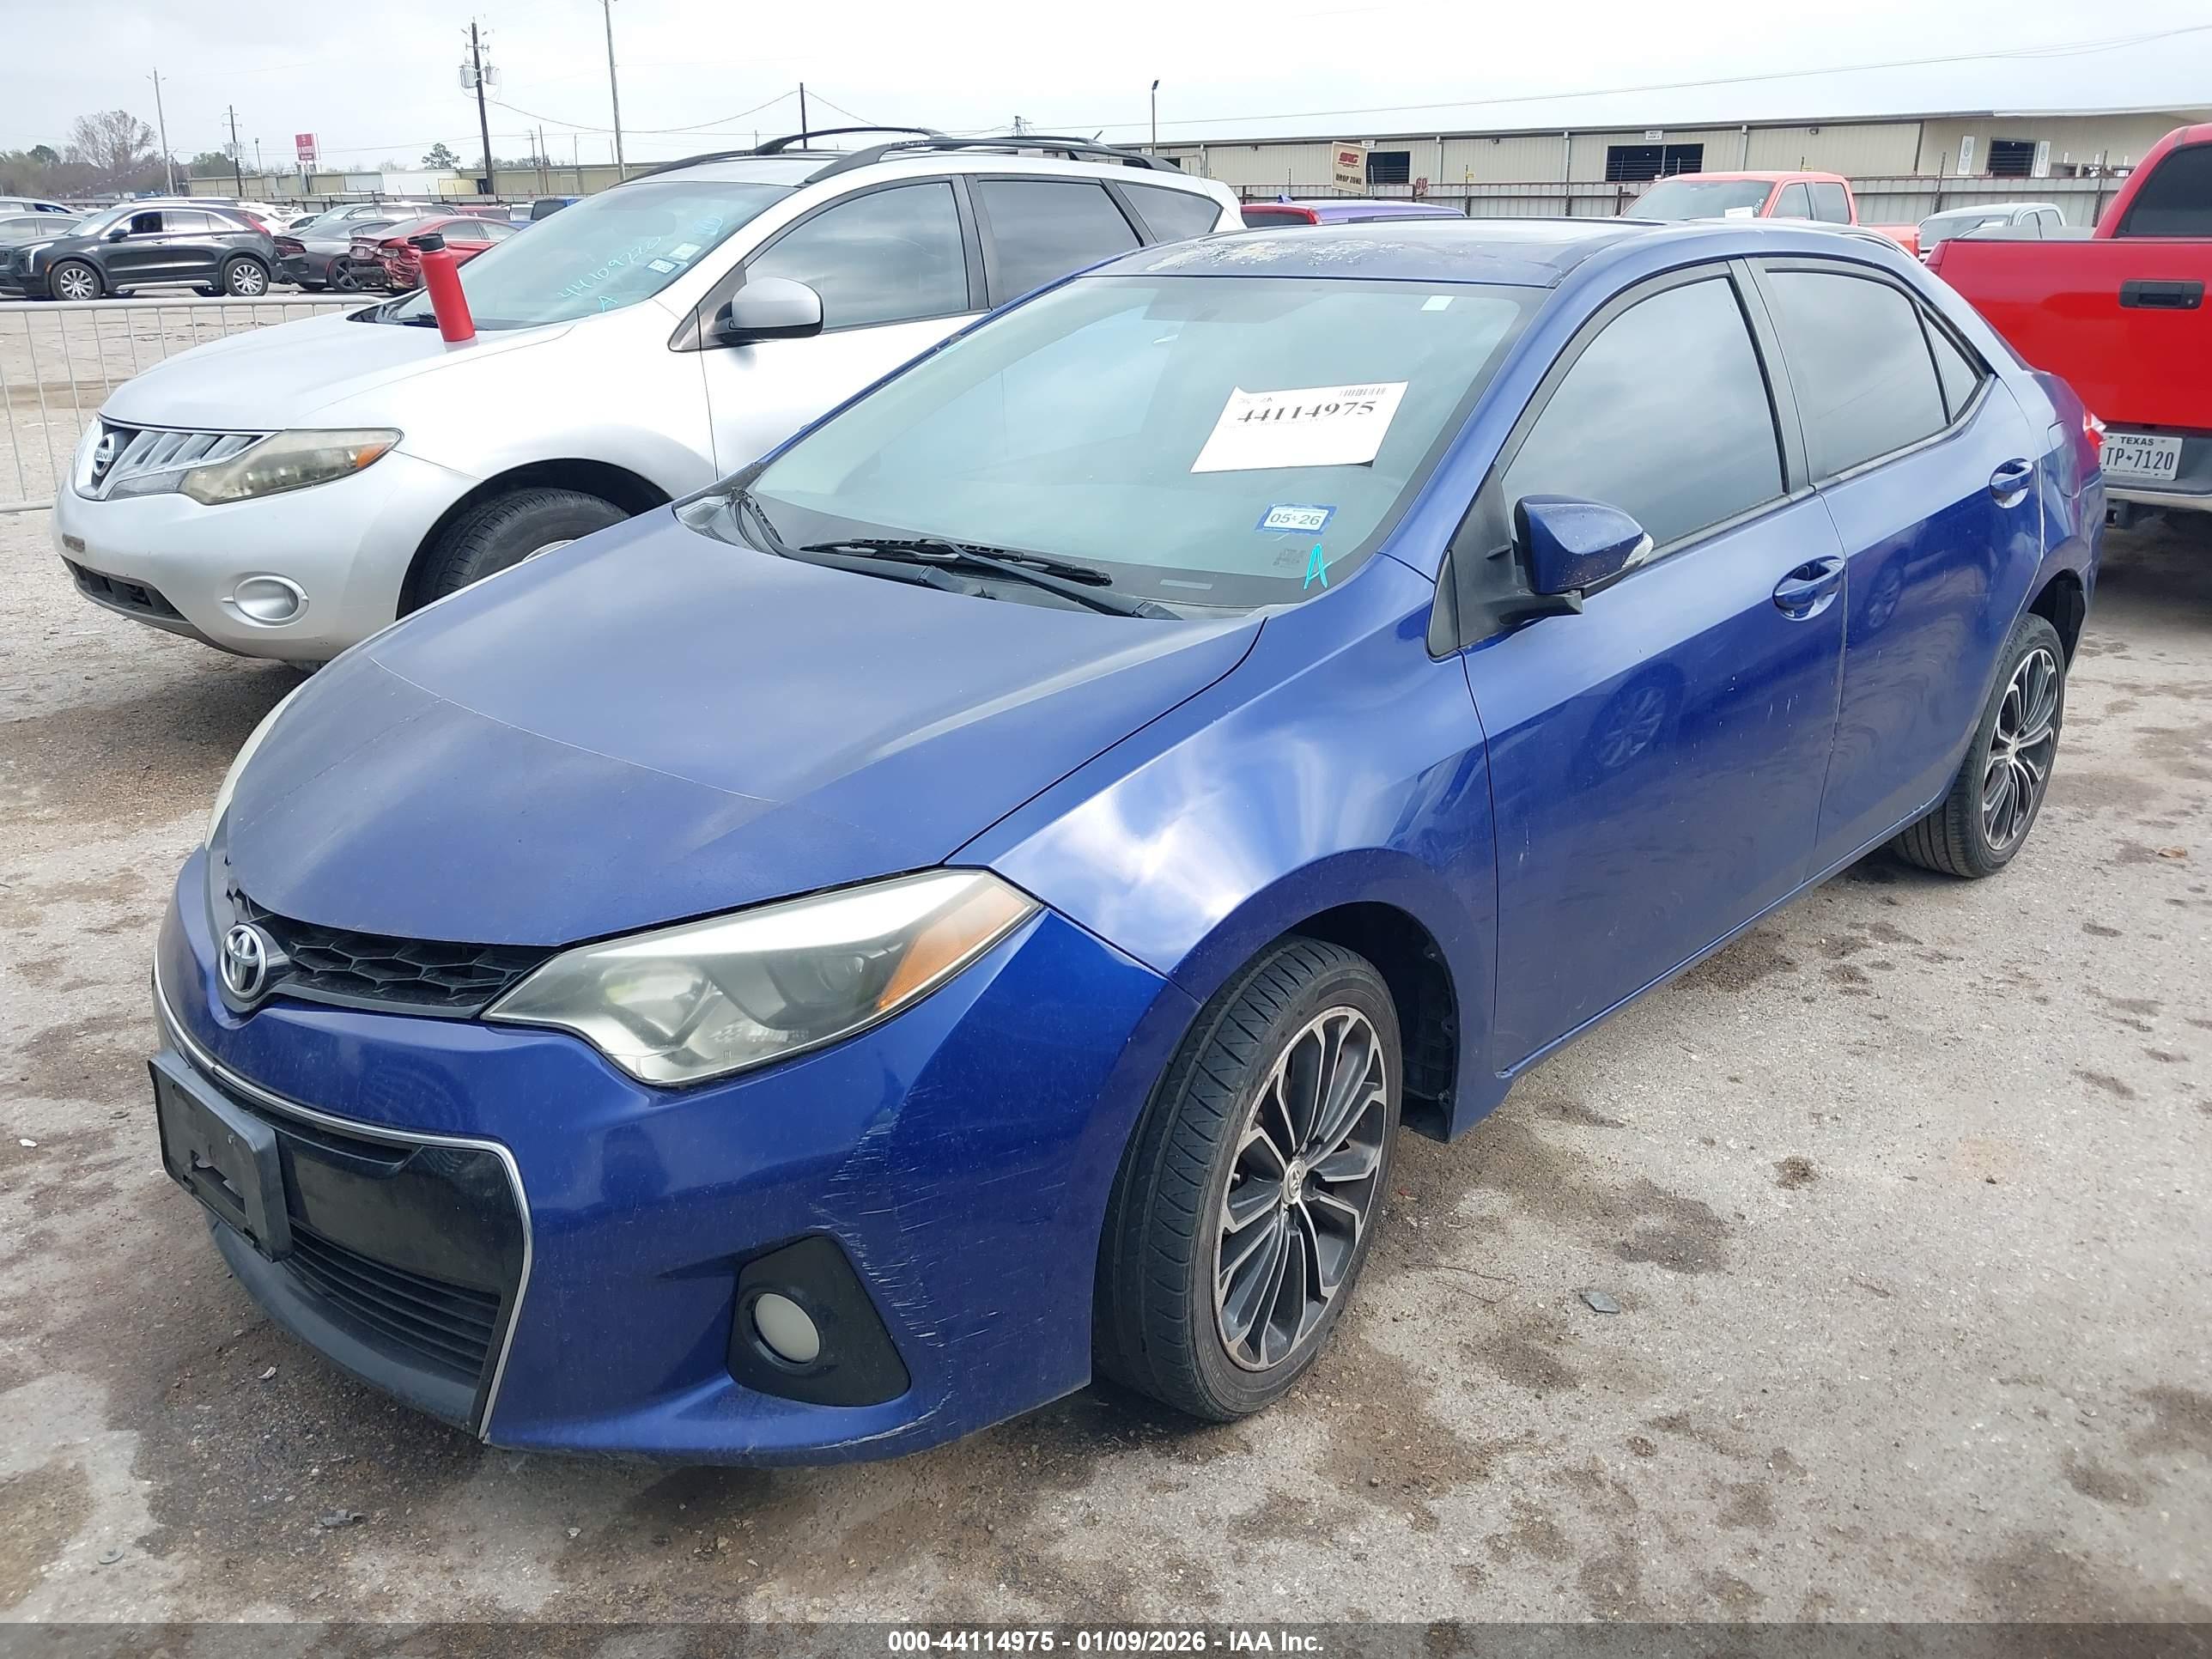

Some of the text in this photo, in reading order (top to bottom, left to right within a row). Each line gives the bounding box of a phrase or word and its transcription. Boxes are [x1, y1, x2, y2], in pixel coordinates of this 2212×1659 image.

[1335, 173, 1362, 185] DROP ZONE
[1415, 178, 1428, 190] 60
[598, 295, 618, 313] A
[1237, 400, 1377, 423] 44114975
[2120, 436, 2154, 446] TEXAS
[1303, 543, 1334, 590] A
